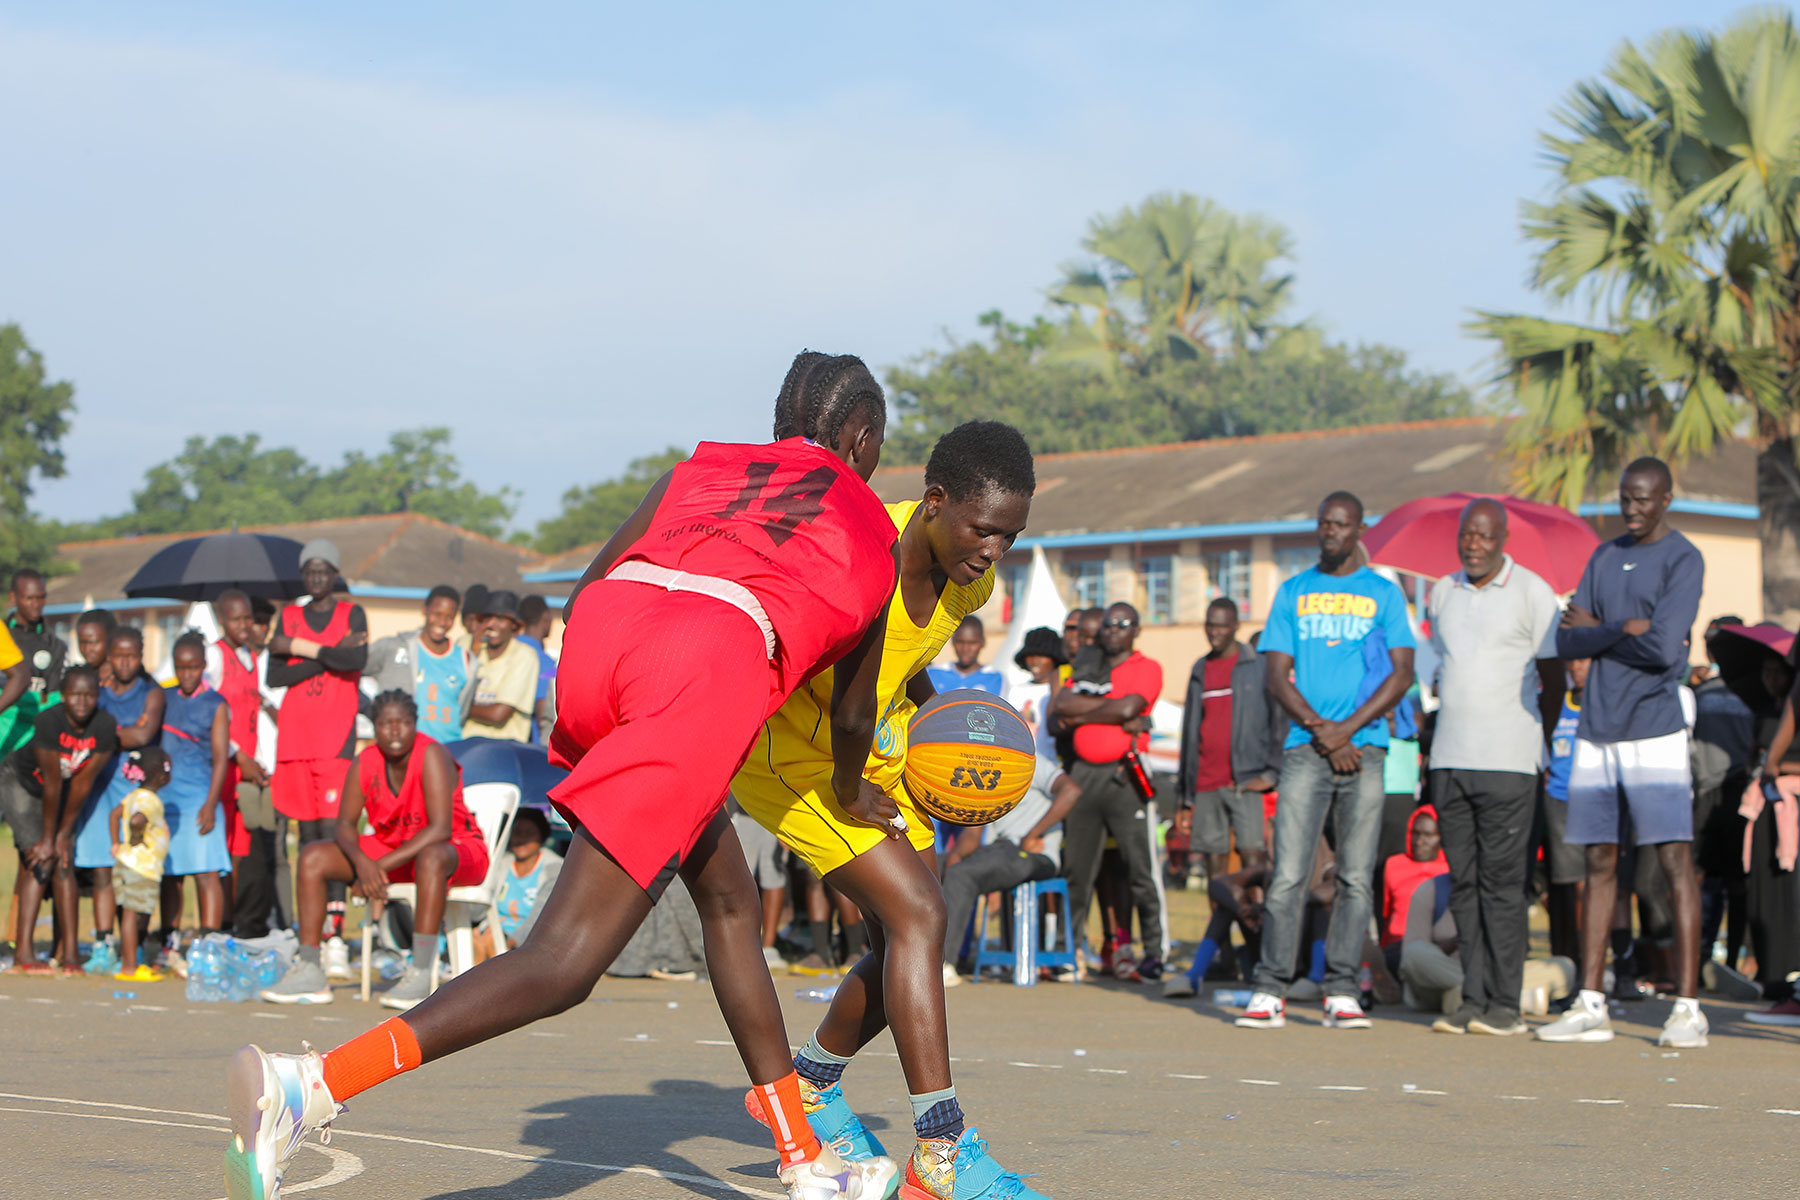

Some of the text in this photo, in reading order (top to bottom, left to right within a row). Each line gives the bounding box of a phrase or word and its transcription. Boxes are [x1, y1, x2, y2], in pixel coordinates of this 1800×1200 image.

[713, 462, 840, 547] 14
[1297, 592, 1378, 618] LEGEND
[1298, 614, 1375, 641] STATUS
